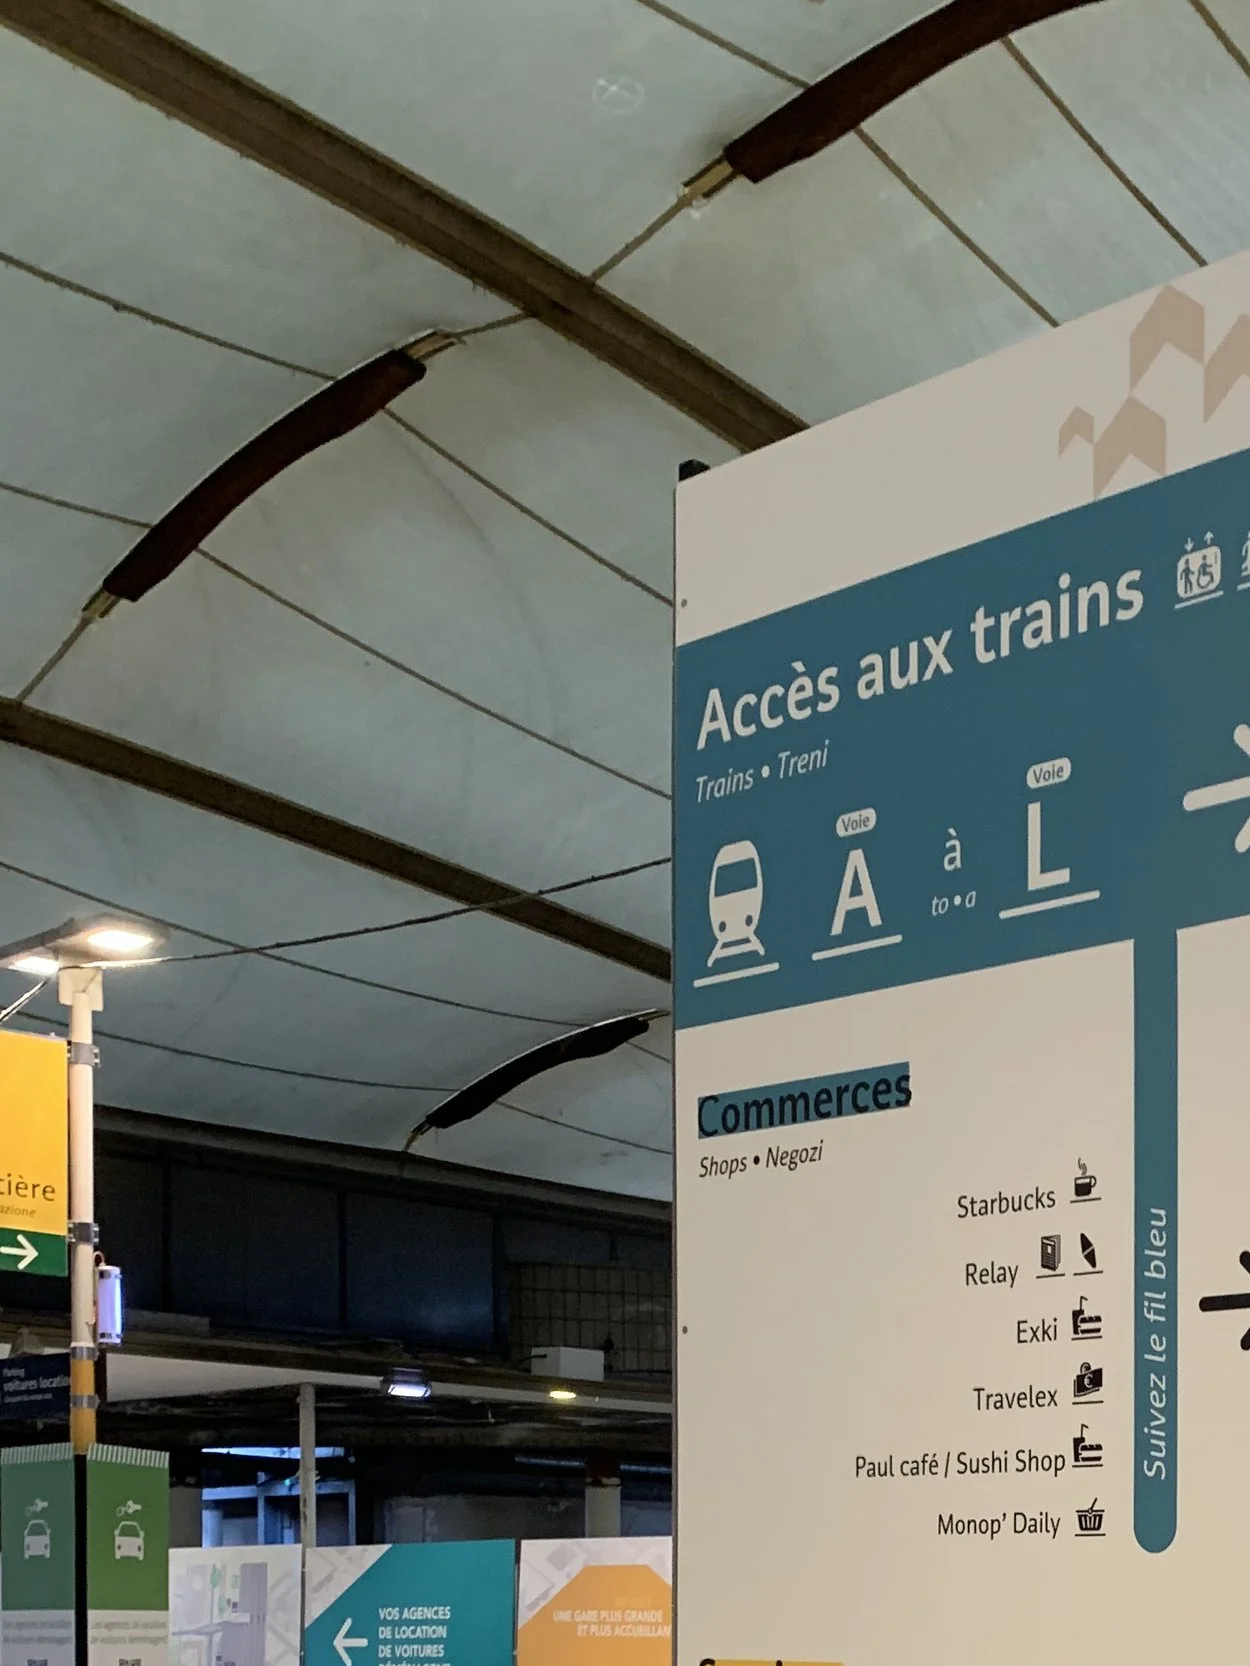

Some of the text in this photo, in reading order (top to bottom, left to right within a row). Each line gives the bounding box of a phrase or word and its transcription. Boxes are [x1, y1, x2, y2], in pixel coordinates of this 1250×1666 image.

[696, 569, 1145, 750] Accès aux trains
[695, 740, 829, 802] Trains Treni
[1032, 763, 1065, 783] Voie
[841, 813, 871, 834] Voie
[829, 801, 1071, 936] A à L
[698, 1071, 913, 1138] Commerces
[699, 1140, 824, 1179] Shops Negozi
[957, 1187, 1057, 1219] Starbucks
[964, 1261, 1019, 1289] Relay
[1016, 1318, 1058, 1345] Exki
[1143, 1206, 1168, 1481] Suivez le fil bleu
[40, 1376, 70, 1388] locatio
[973, 1385, 1059, 1411] Travelex
[855, 1448, 1066, 1479] Paul café Sushi Shop
[1012, 1510, 1061, 1539] Daily
[378, 1606, 451, 1620] VOS AGENCES
[600, 1610, 622, 1622] PLUS
[624, 1609, 663, 1622] GRANDE
[378, 1625, 447, 1639] DE LOCATION
[590, 1625, 612, 1637] PLUS
[614, 1624, 671, 1637] ACCUEILLAN
[378, 1644, 444, 1658] DE VOITURES
